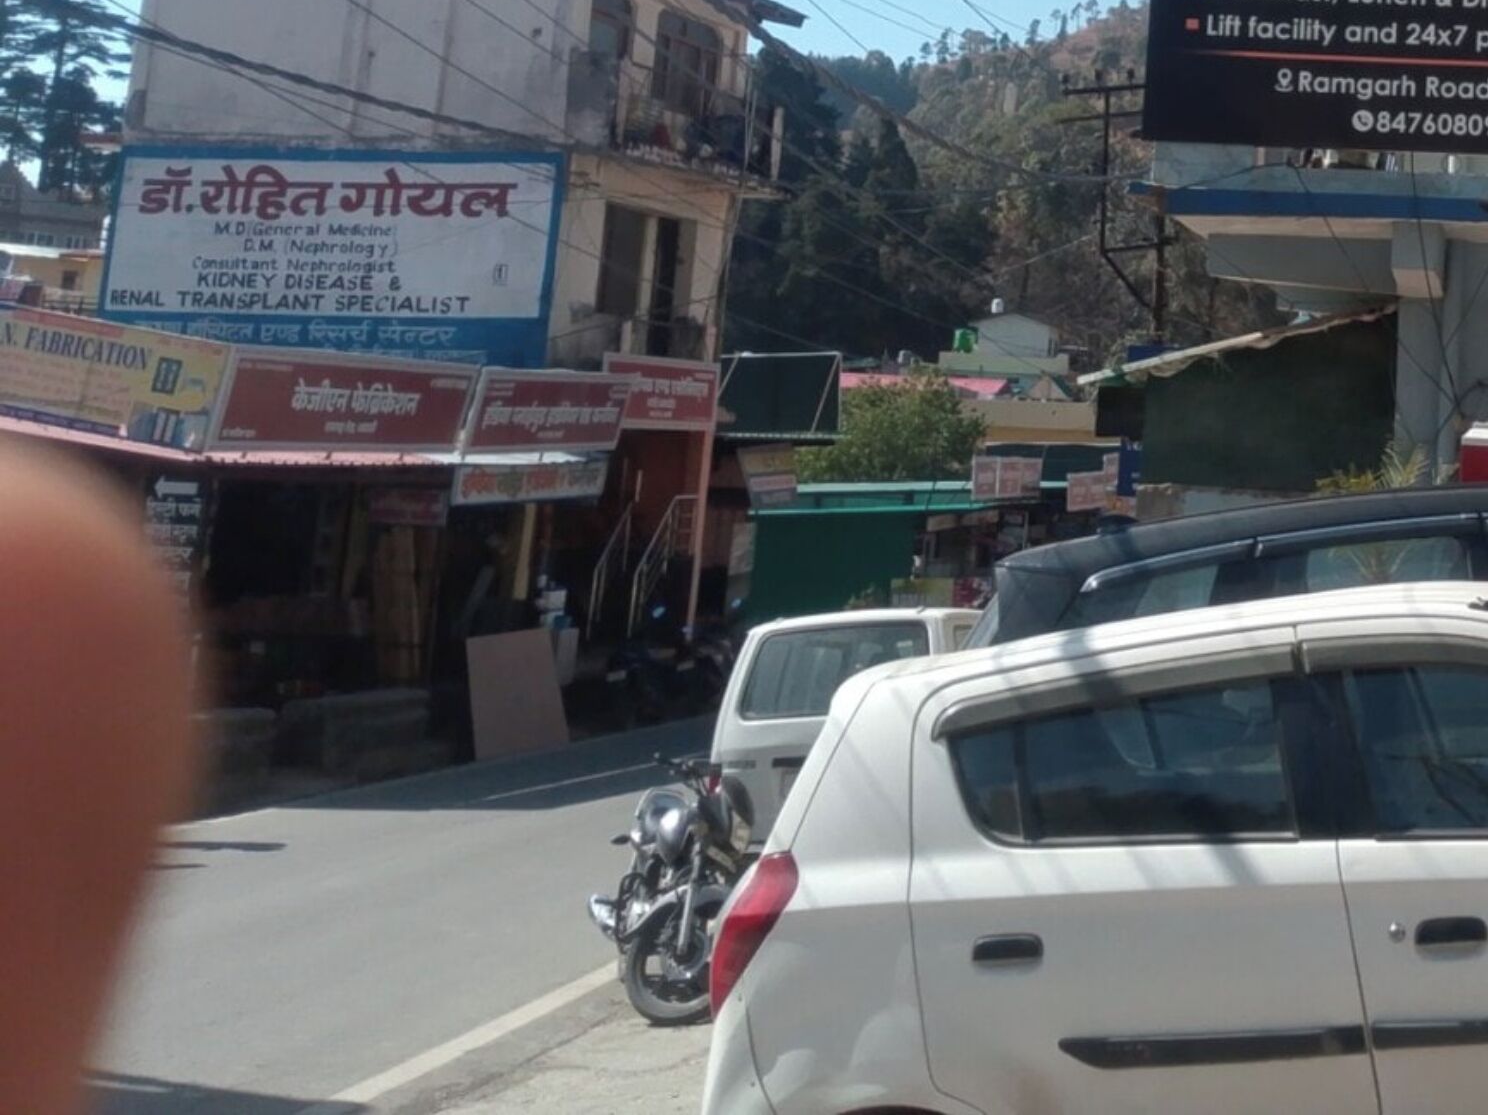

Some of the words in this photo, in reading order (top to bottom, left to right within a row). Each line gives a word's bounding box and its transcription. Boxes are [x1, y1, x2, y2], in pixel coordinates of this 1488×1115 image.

[1205, 14, 1244, 38] Lift
[1247, 16, 1338, 48] facility
[1344, 19, 1398, 45] and
[1405, 24, 1469, 48] 24x7
[1298, 69, 1417, 102] Ramgarh
[199, 164, 334, 221] रोहित
[339, 167, 518, 219] गोयल
[192, 255, 279, 272] Consultant
[287, 257, 397, 274] Nephrologist
[197, 272, 278, 290] KIDNEY
[284, 273, 374, 291] DISEASE
[110, 289, 165, 308] RENAL
[175, 290, 326, 312] TRANSPLANT
[334, 294, 471, 314] SPECIALIST
[23, 326, 151, 371] FABRICATION
